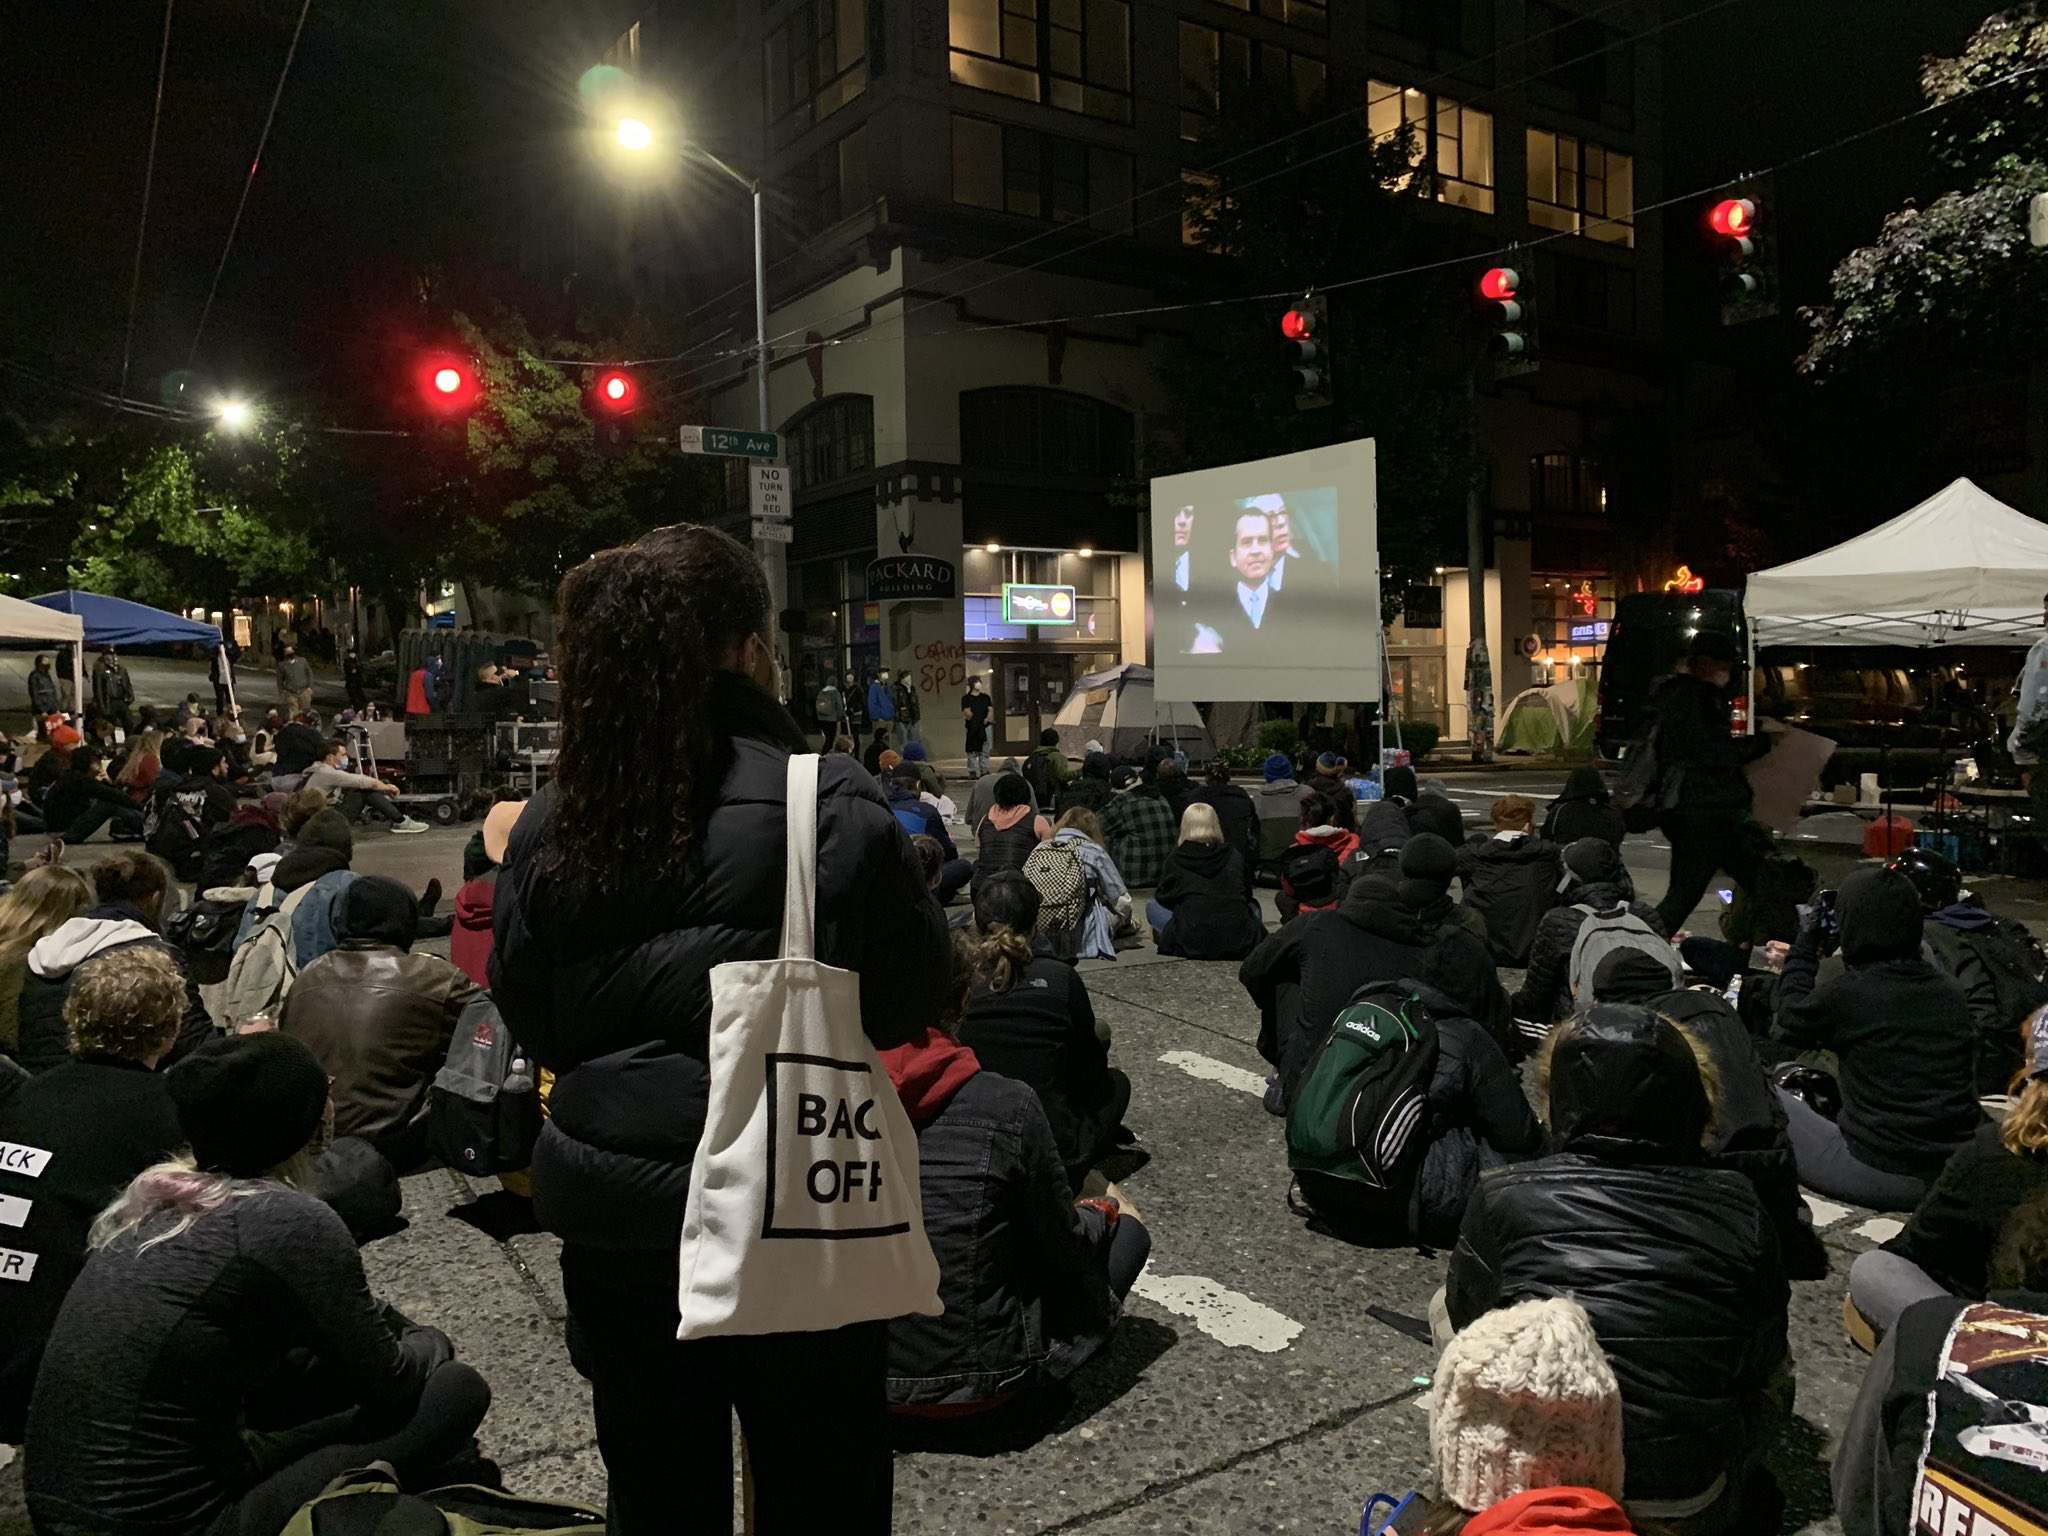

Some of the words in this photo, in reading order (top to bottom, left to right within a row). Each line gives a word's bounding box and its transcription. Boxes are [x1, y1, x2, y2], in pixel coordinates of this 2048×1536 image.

[711, 433, 739, 450] 12th
[746, 438, 770, 451] Ave
[761, 469, 780, 480] NO
[760, 482, 783, 492] TURN
[765, 493, 778, 503] ON
[763, 504, 781, 514] RED
[870, 562, 951, 584] PACKARD
[880, 584, 933, 592] BUILDING
[1346, 1021, 1381, 1041] adidas
[797, 1093, 882, 1140] BAC
